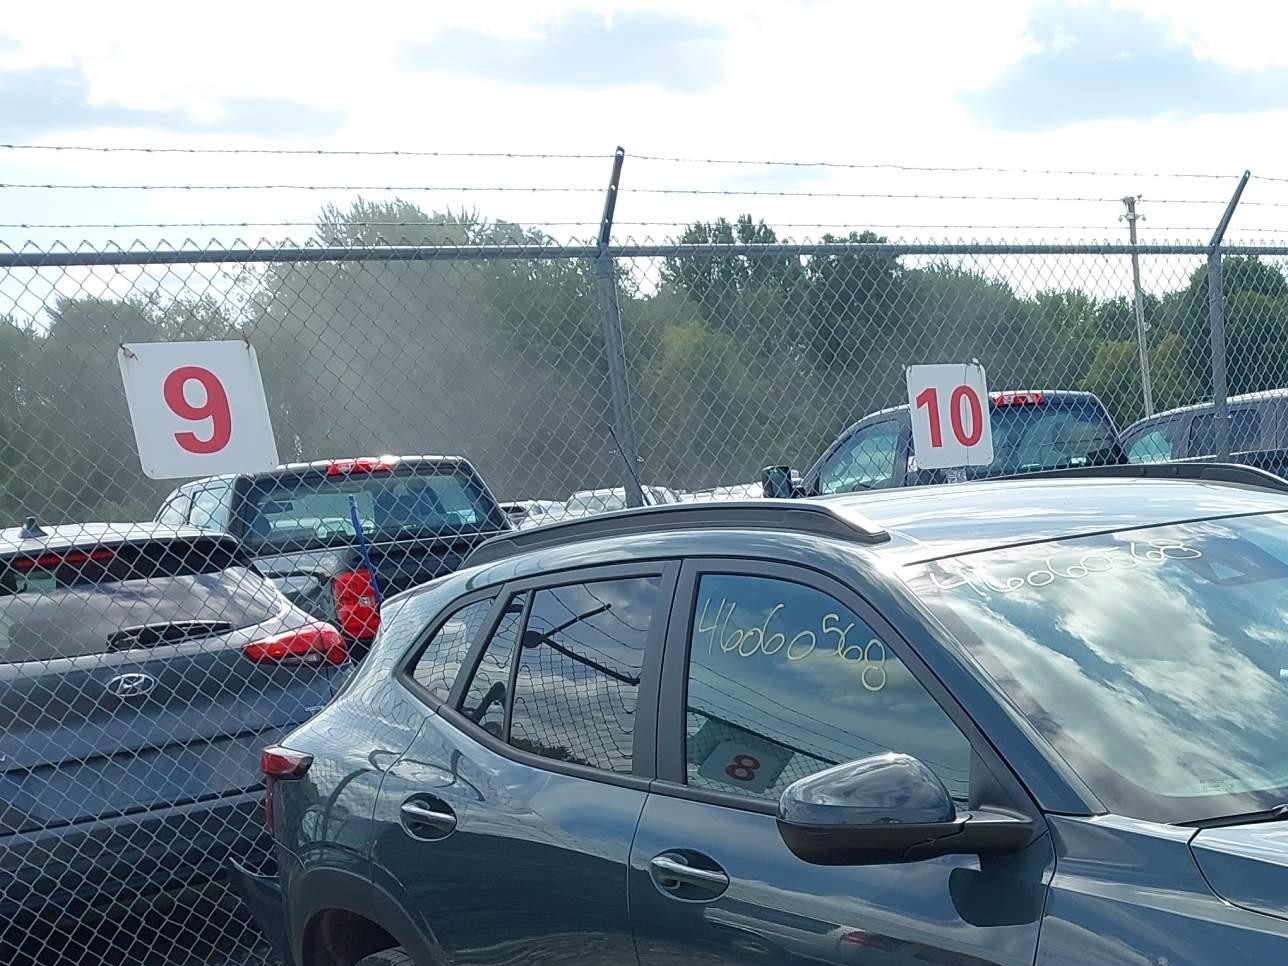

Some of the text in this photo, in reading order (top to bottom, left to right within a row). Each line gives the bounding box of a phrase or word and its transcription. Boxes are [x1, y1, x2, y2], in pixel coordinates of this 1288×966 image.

[163, 365, 232, 455] 9
[915, 384, 984, 448] 10
[930, 539, 1202, 601] 46060568
[698, 597, 887, 692] 46060568
